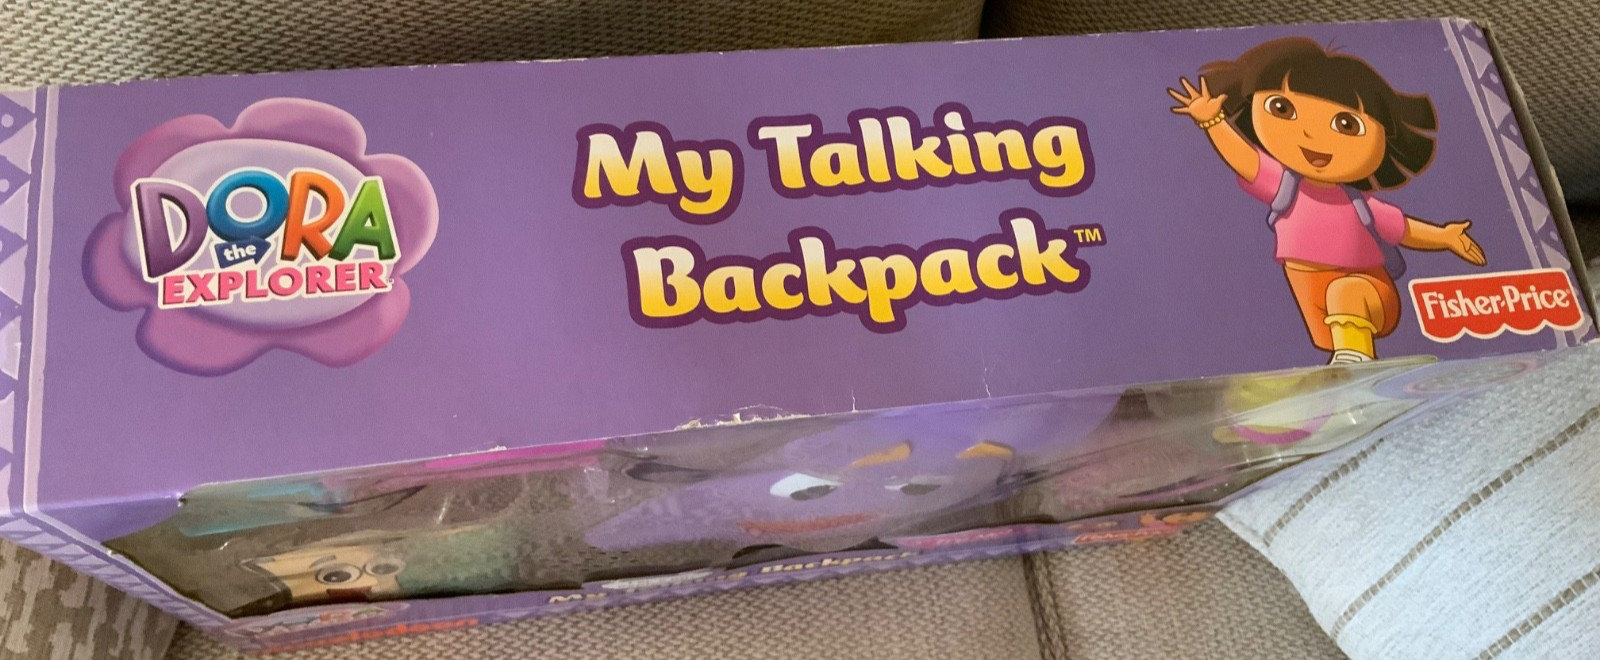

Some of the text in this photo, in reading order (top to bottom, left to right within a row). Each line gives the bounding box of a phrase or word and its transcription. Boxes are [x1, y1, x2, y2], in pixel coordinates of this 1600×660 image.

[583, 110, 1085, 215] My Talking
[135, 169, 397, 279] DORA
[223, 242, 257, 262] the
